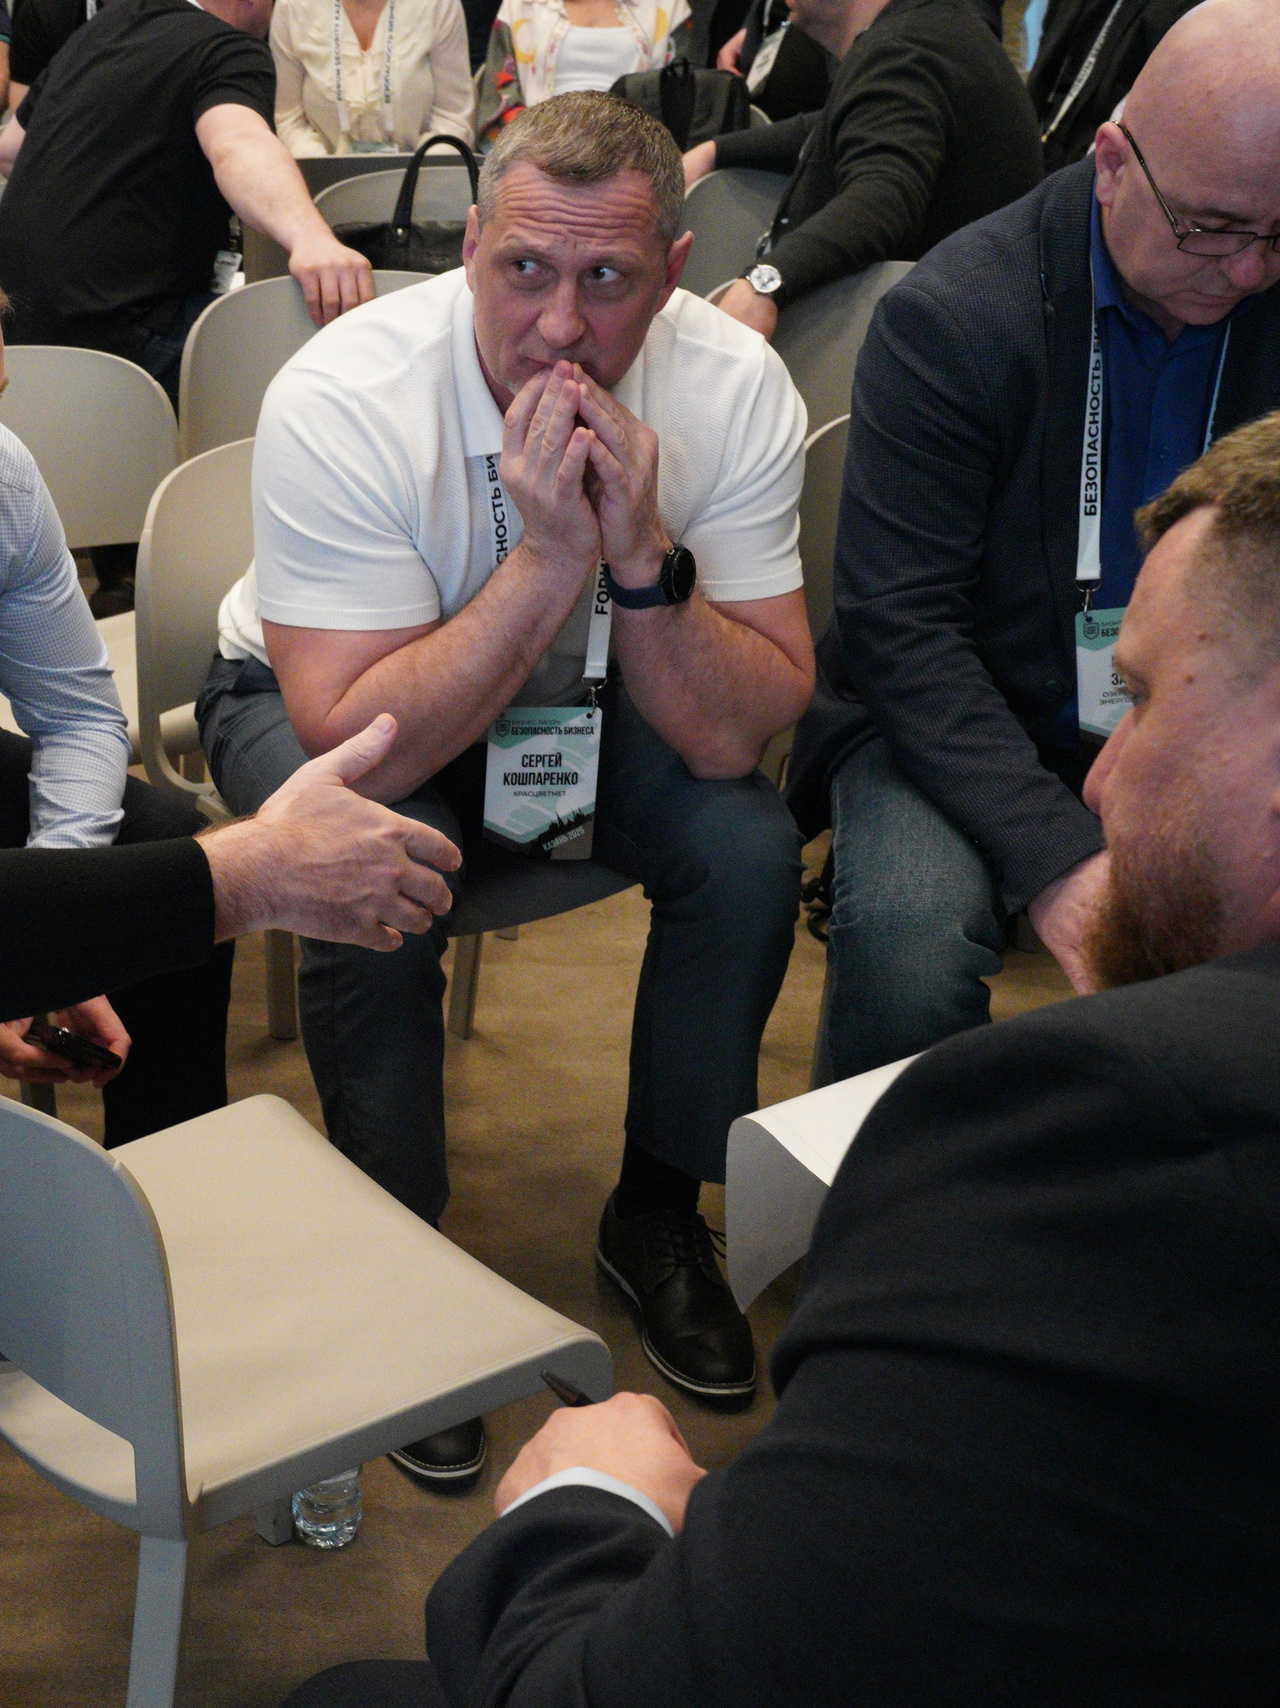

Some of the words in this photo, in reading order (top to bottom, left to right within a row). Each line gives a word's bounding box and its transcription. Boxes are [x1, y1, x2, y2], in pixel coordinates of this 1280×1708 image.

[1084, 358, 1101, 517] БЕЗОПАСНОСТЬ
[511, 726, 563, 736] БЕЗОПАСНОСТЬ
[564, 726, 595, 736] БИЗНЕСА
[521, 752, 563, 768] СЕРГЕЙ
[503, 771, 579, 786] КОШПАРЕНКО
[513, 790, 567, 798] КРАСЦВЕТМЕТ
[542, 834, 569, 852] КАЗАНЬ
